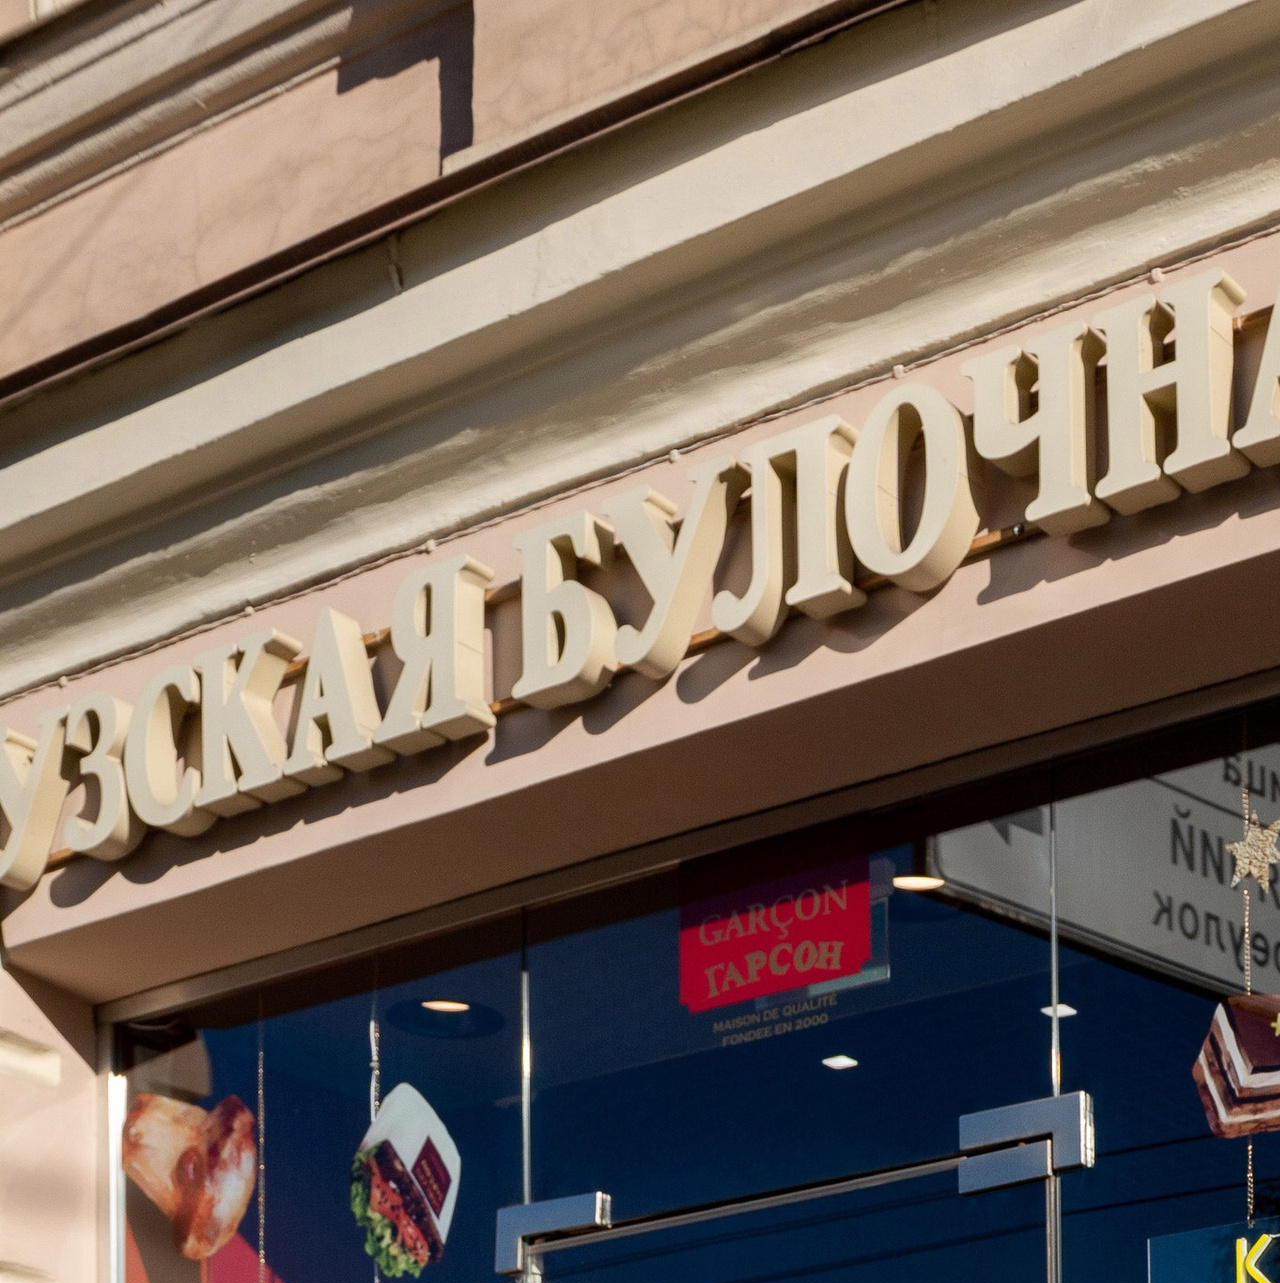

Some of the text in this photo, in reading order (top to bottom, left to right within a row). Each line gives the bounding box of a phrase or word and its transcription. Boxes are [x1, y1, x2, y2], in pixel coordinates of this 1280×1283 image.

[698, 879, 849, 947] GARÇON
[703, 940, 845, 999] ГАРСОН
[712, 1012, 761, 1033] MAISON
[795, 1013, 829, 1029] 2000
